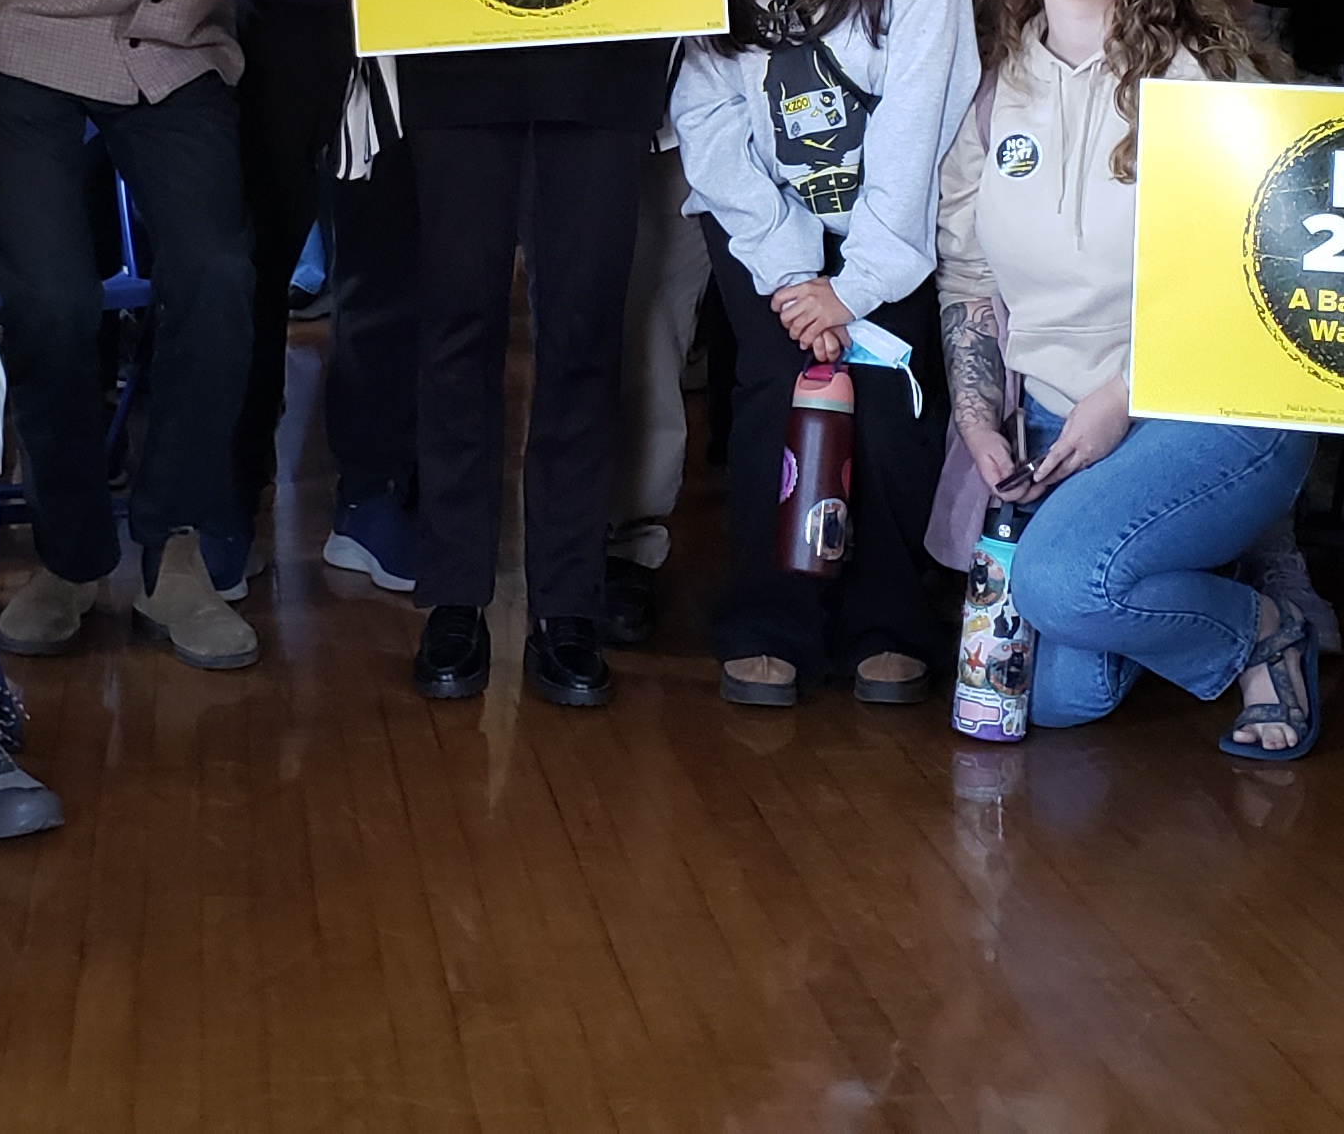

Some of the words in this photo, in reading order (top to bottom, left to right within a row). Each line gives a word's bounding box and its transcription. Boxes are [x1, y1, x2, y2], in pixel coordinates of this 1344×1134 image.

[1006, 137, 1027, 151] NO
[1002, 147, 1033, 162] 2117
[1288, 288, 1311, 311] A
